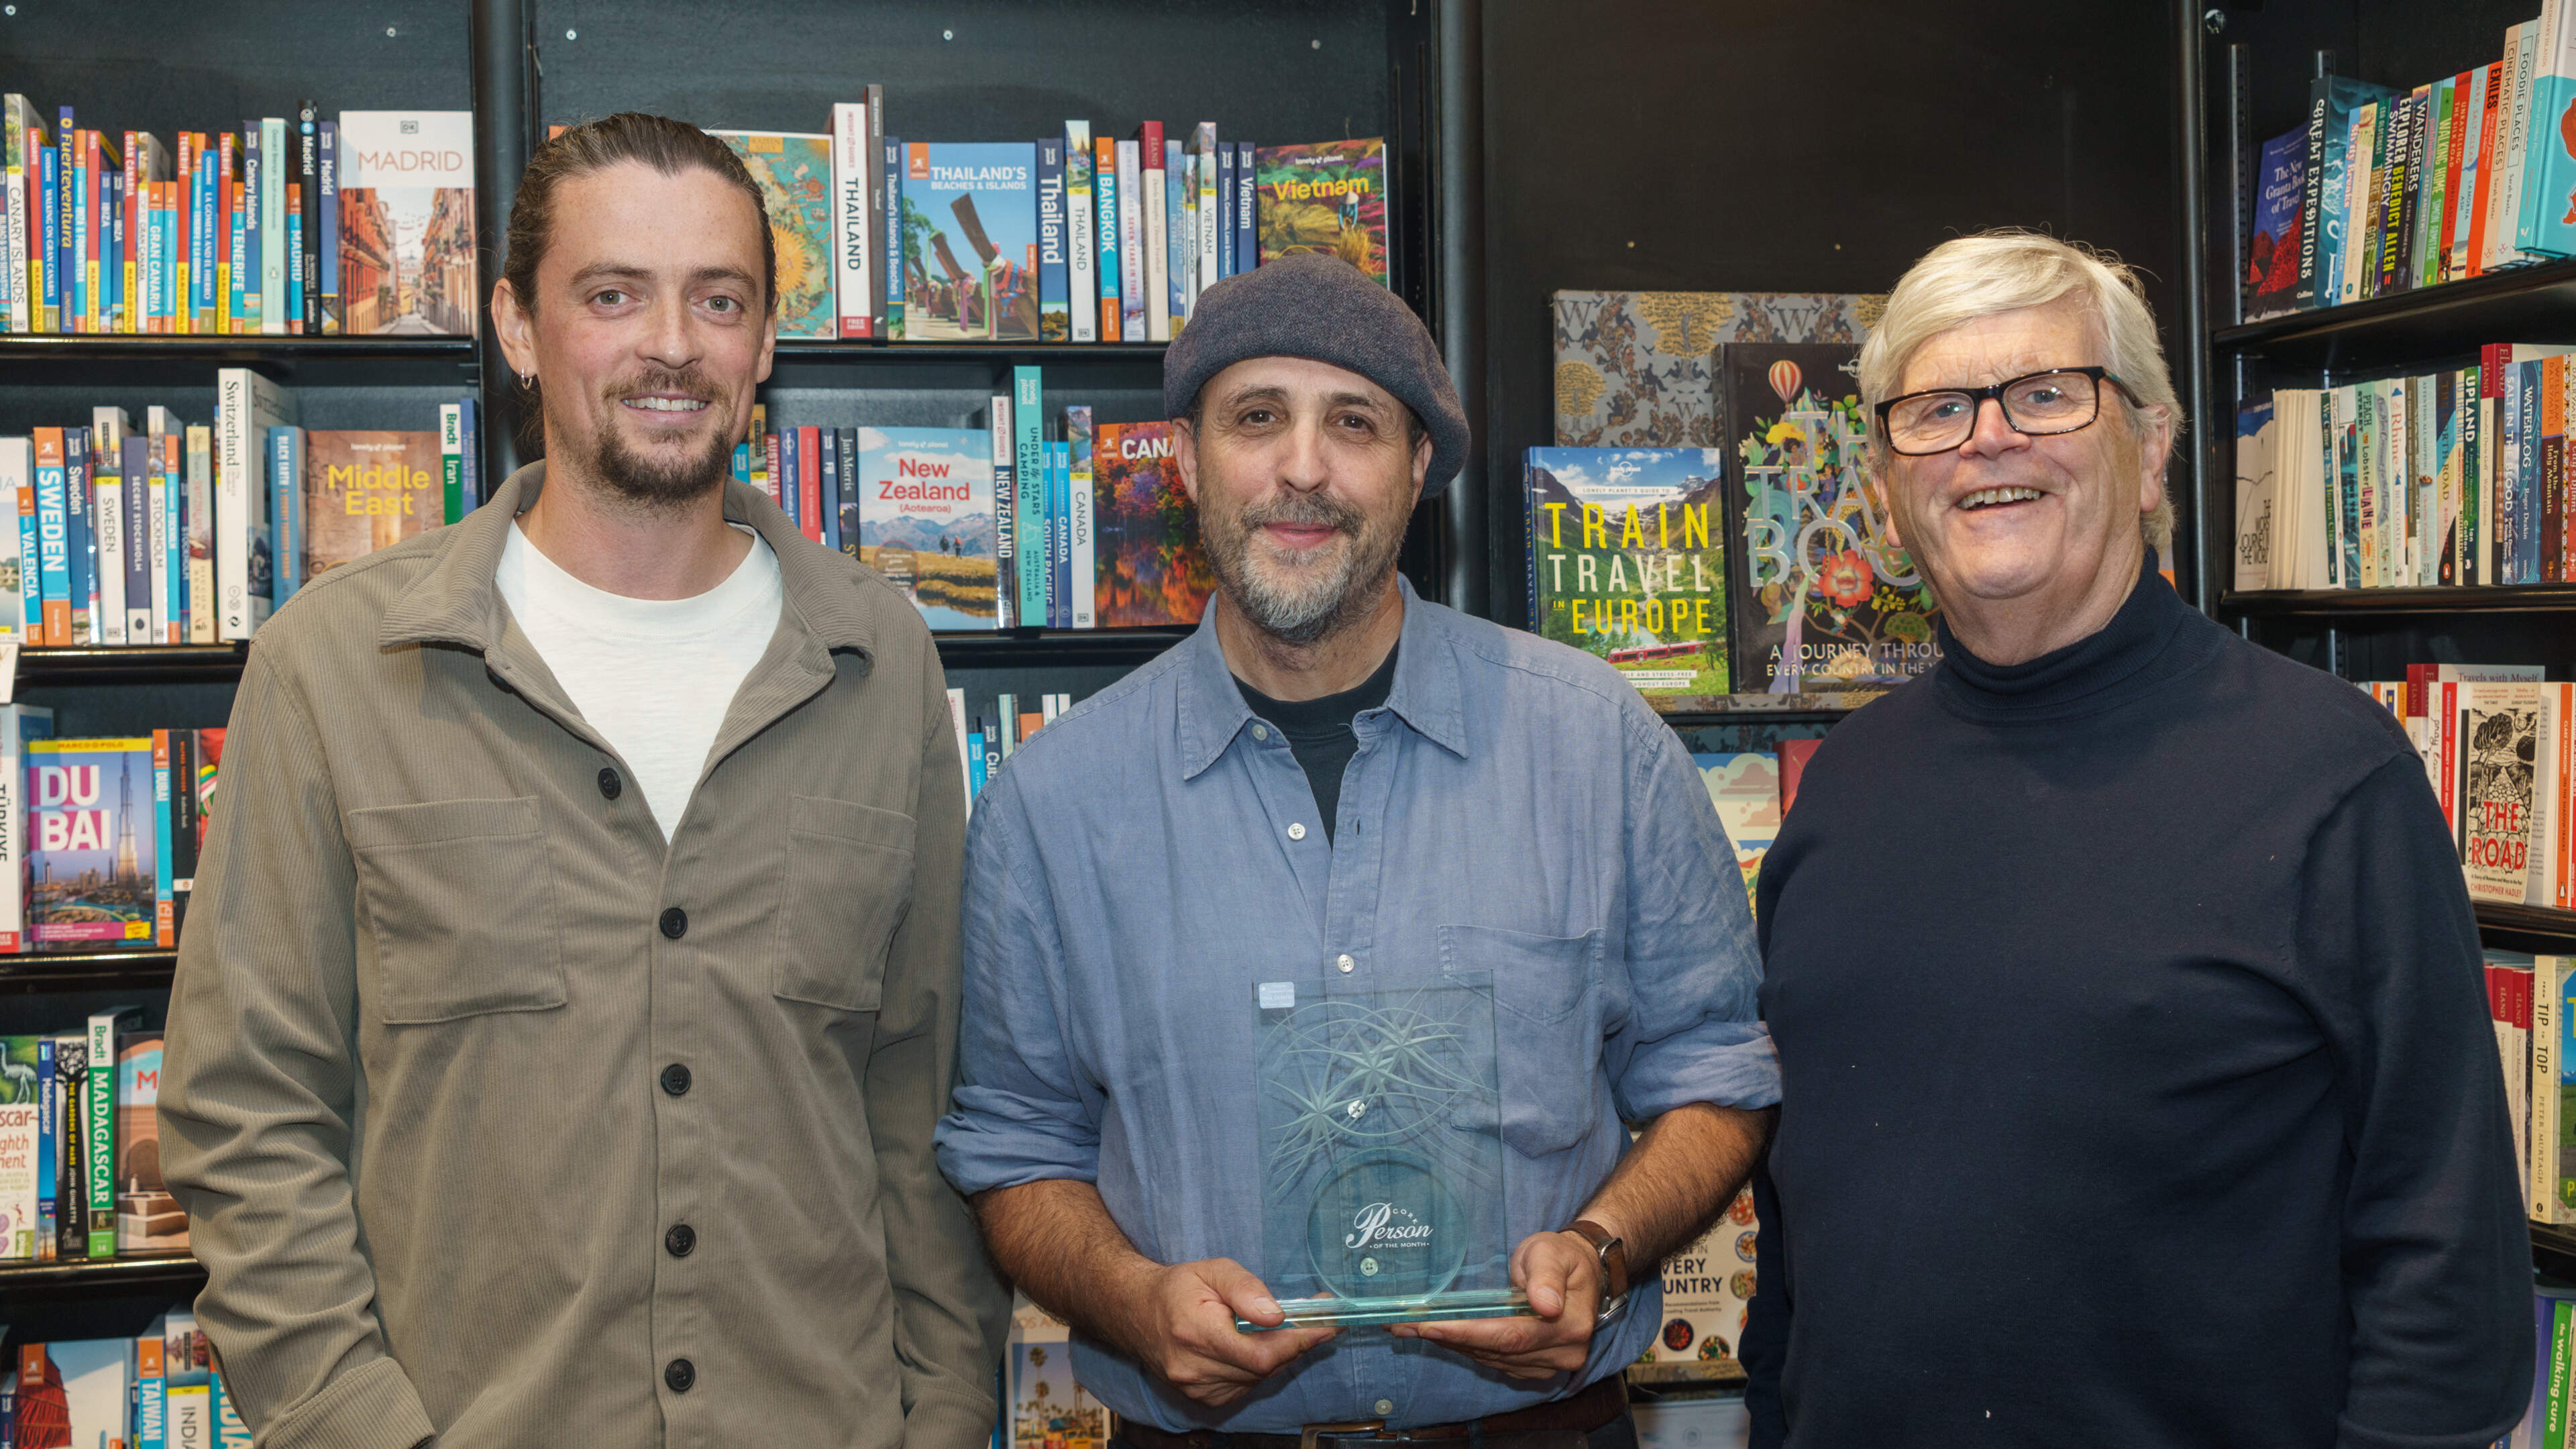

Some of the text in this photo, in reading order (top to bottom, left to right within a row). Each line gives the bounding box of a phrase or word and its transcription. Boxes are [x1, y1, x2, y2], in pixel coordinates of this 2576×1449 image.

[2487, 67, 2502, 110] EXILES
[2496, 48, 2514, 166] CINEMATIC PLACES
[2512, 52, 2529, 151] FOODIE PLACES
[2394, 97, 2412, 164] EXPLORER
[2408, 101, 2426, 192] WANDERERS
[2456, 102, 2467, 164] UNRAVELLING
[179, 136, 189, 176] TENERIFE
[221, 136, 231, 176] TENERIFE
[303, 136, 315, 175] Madrid
[358, 150, 463, 172] MADRID
[931, 166, 1027, 181] THAILAND'S
[2275, 160, 2303, 182] The New
[2381, 109, 2398, 207] SWIMMINGLY
[60, 133, 73, 248] Fuerteventura
[245, 159, 258, 230] Canary Islands
[321, 160, 333, 195] Madrid
[887, 174, 896, 217] Thailand's
[931, 181, 1026, 190] BEACHES & ISLANDS
[1273, 177, 1368, 201] Vietnam
[2266, 183, 2290, 200] Granta
[2301, 99, 2324, 279] GREAT EXPEDITIONS
[2387, 165, 2404, 228] BENEDICT
[2426, 118, 2452, 262] WALKING HOME SIMON ARMITAGE
[1040, 174, 1063, 264] Thailand
[1099, 176, 1116, 253] BANGKOK
[1240, 176, 1253, 229] Vietnam
[2271, 188, 2300, 214] of Travel
[2464, 180, 2473, 220] LAMORNA
[9, 186, 24, 304] CANARY ISLANDS
[845, 177, 861, 271] THAILAND
[888, 218, 897, 249] Islands
[1075, 207, 1087, 271] THAILAND
[1203, 207, 1213, 254] VIETNAM
[149, 226, 161, 313] GRAN CANARIA
[232, 228, 245, 291] TENERIFE
[291, 229, 302, 282] MADRID
[2383, 233, 2398, 272] ALLEN
[888, 258, 899, 295] Beaches
[1020, 379, 1028, 405] planet
[2363, 394, 2371, 427] PEACH
[2465, 376, 2476, 442] UPLAND
[224, 380, 239, 468] Switzerland
[1030, 427, 1039, 464] UNDER
[2392, 412, 2403, 466] Rhine
[2505, 376, 2515, 512] SALT IN THE BLOOD
[2522, 385, 2533, 468] WATERLOG
[446, 413, 459, 484] Bradt Iran
[841, 437, 853, 491] Jan Morris
[898, 459, 950, 478] New
[1121, 437, 1175, 460] CAN
[68, 466, 83, 515] Sweden
[327, 464, 430, 490] Middle
[878, 481, 970, 500] Zealand
[1020, 443, 1029, 499] CAMPING
[345, 491, 414, 515] East
[900, 504, 951, 513] (Aotearoa)
[996, 471, 1013, 559] NEW ZEALAND
[1032, 483, 1040, 515] STARS
[1075, 491, 1086, 546] CANADA
[2361, 487, 2373, 530] LANE
[38, 470, 64, 572] SWEDEN
[103, 497, 115, 553] SWEDEN
[153, 498, 164, 569] STOCKHOLM
[1059, 516, 1068, 564] CANADA
[1544, 502, 1709, 549] TRAIN
[21, 531, 38, 599] VALENCIA
[1548, 554, 1711, 592] TRAVEL
[1553, 598, 1711, 633] IN EUROPE
[1766, 662, 1925, 676] EVERY COUNTRY IN THE
[1770, 643, 1943, 663] A JOURNEY THROU
[2458, 672, 2538, 682] Travels with Myself
[39, 765, 100, 806] DU
[985, 751, 1000, 779] Cub
[2562, 777, 2567, 788] ON
[40, 810, 110, 851] BAI
[2483, 801, 2519, 833] THE
[2471, 837, 2525, 870] ROAD
[2471, 883, 2522, 898] CHRISTOPHER HADLEY
[2538, 1003, 2549, 1027] TIP
[2536, 1045, 2548, 1074] TOP
[41, 1077, 52, 1135] Madagascar
[93, 1025, 110, 1203] Bradt MADAGASCAR
[2536, 1132, 2544, 1185] MURTAGH
[1346, 1202, 1434, 1248] Person
[1393, 1208, 1418, 1224] CORK
[1662, 1258, 1706, 1275] VERY
[1663, 1277, 1723, 1295] UNTRY
[2550, 1338, 2565, 1398] walking
[141, 1380, 162, 1441] TAIWAN
[2549, 1399, 2558, 1433] cure
